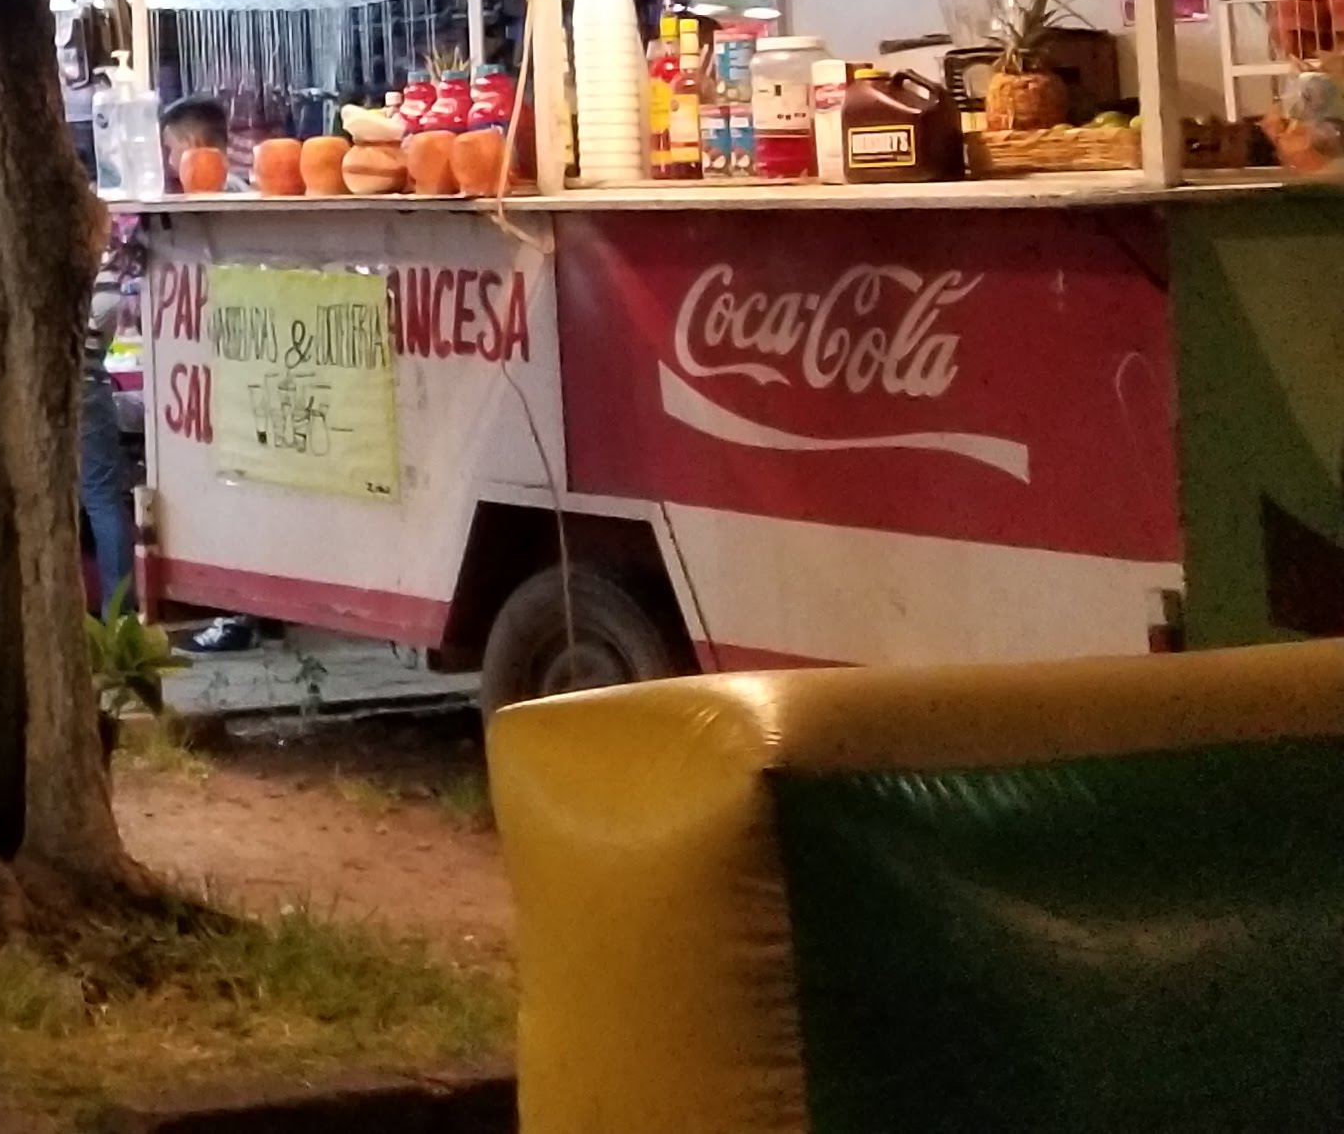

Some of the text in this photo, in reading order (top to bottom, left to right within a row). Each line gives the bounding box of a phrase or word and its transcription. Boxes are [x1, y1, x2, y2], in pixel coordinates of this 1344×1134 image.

[153, 263, 530, 363] PAP ANCESA
[674, 263, 984, 397] Coca-Cola
[165, 363, 213, 445] SAL
